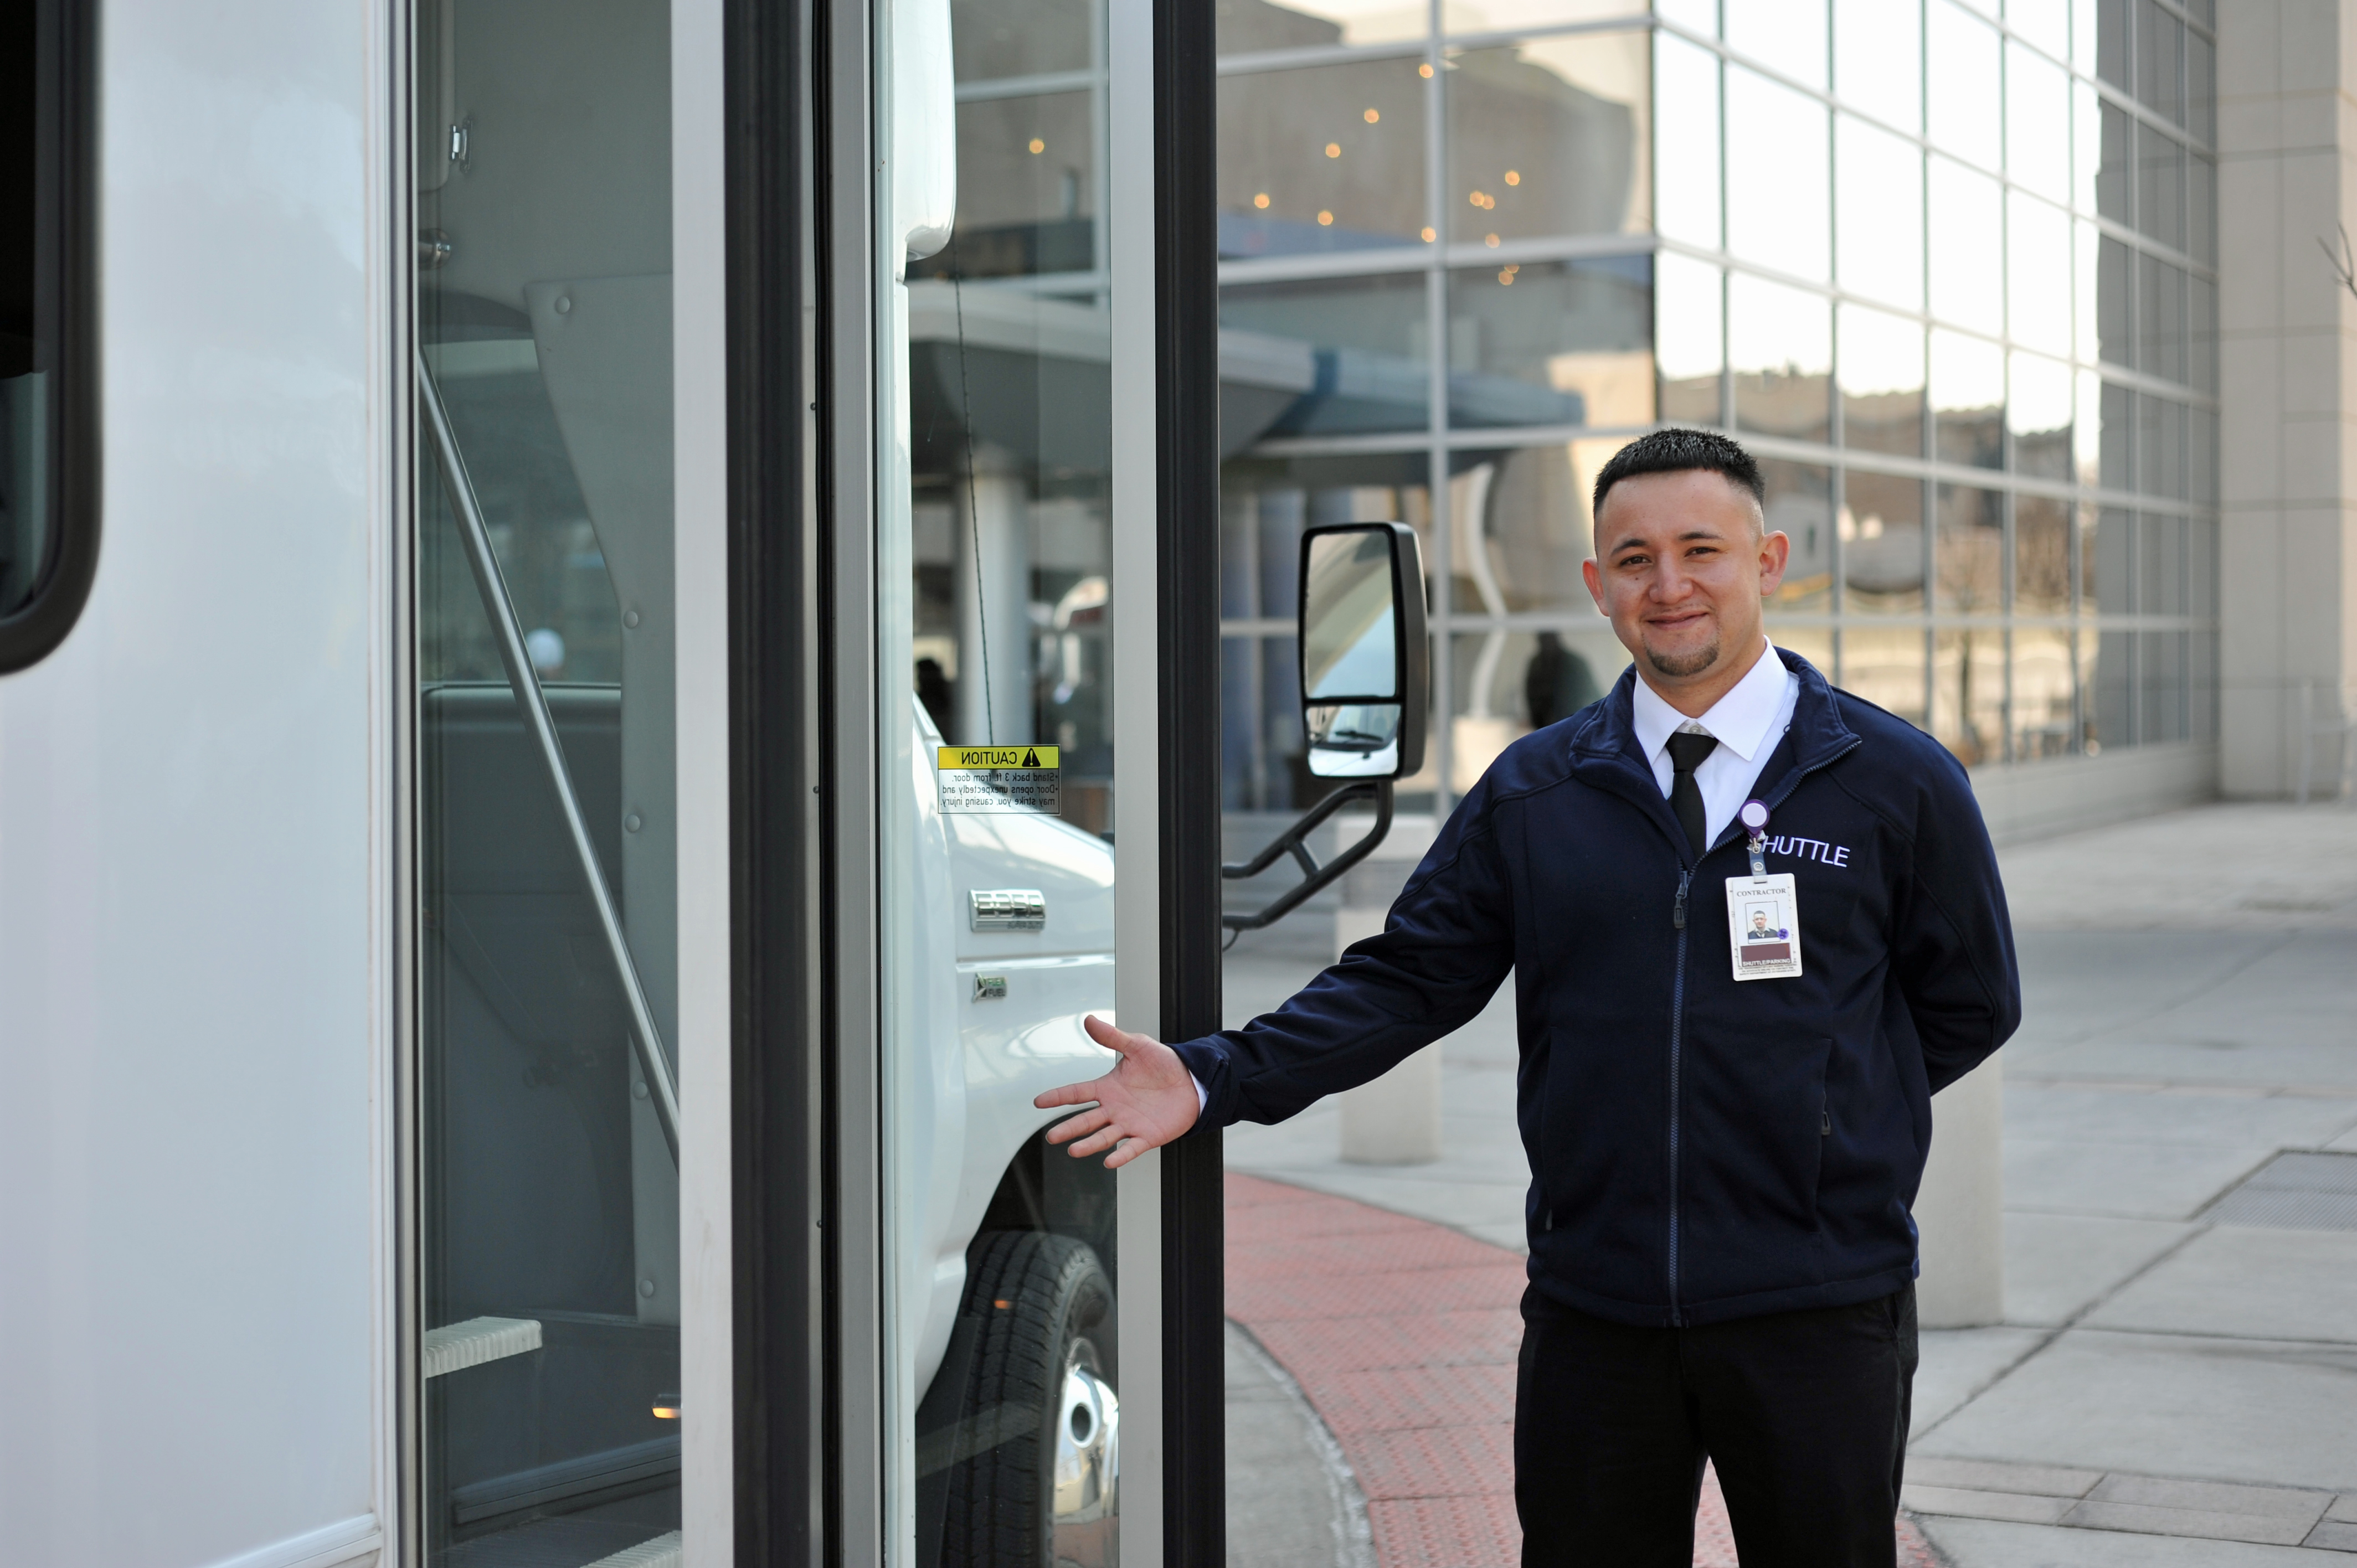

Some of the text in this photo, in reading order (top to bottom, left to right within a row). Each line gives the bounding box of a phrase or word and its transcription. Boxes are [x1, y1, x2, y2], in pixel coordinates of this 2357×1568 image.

[1747, 831, 1850, 868] HUTTLE
[1737, 888, 1787, 897] CONTRACTOR
[1742, 958, 1791, 967] SHUTTLE/PARKING
